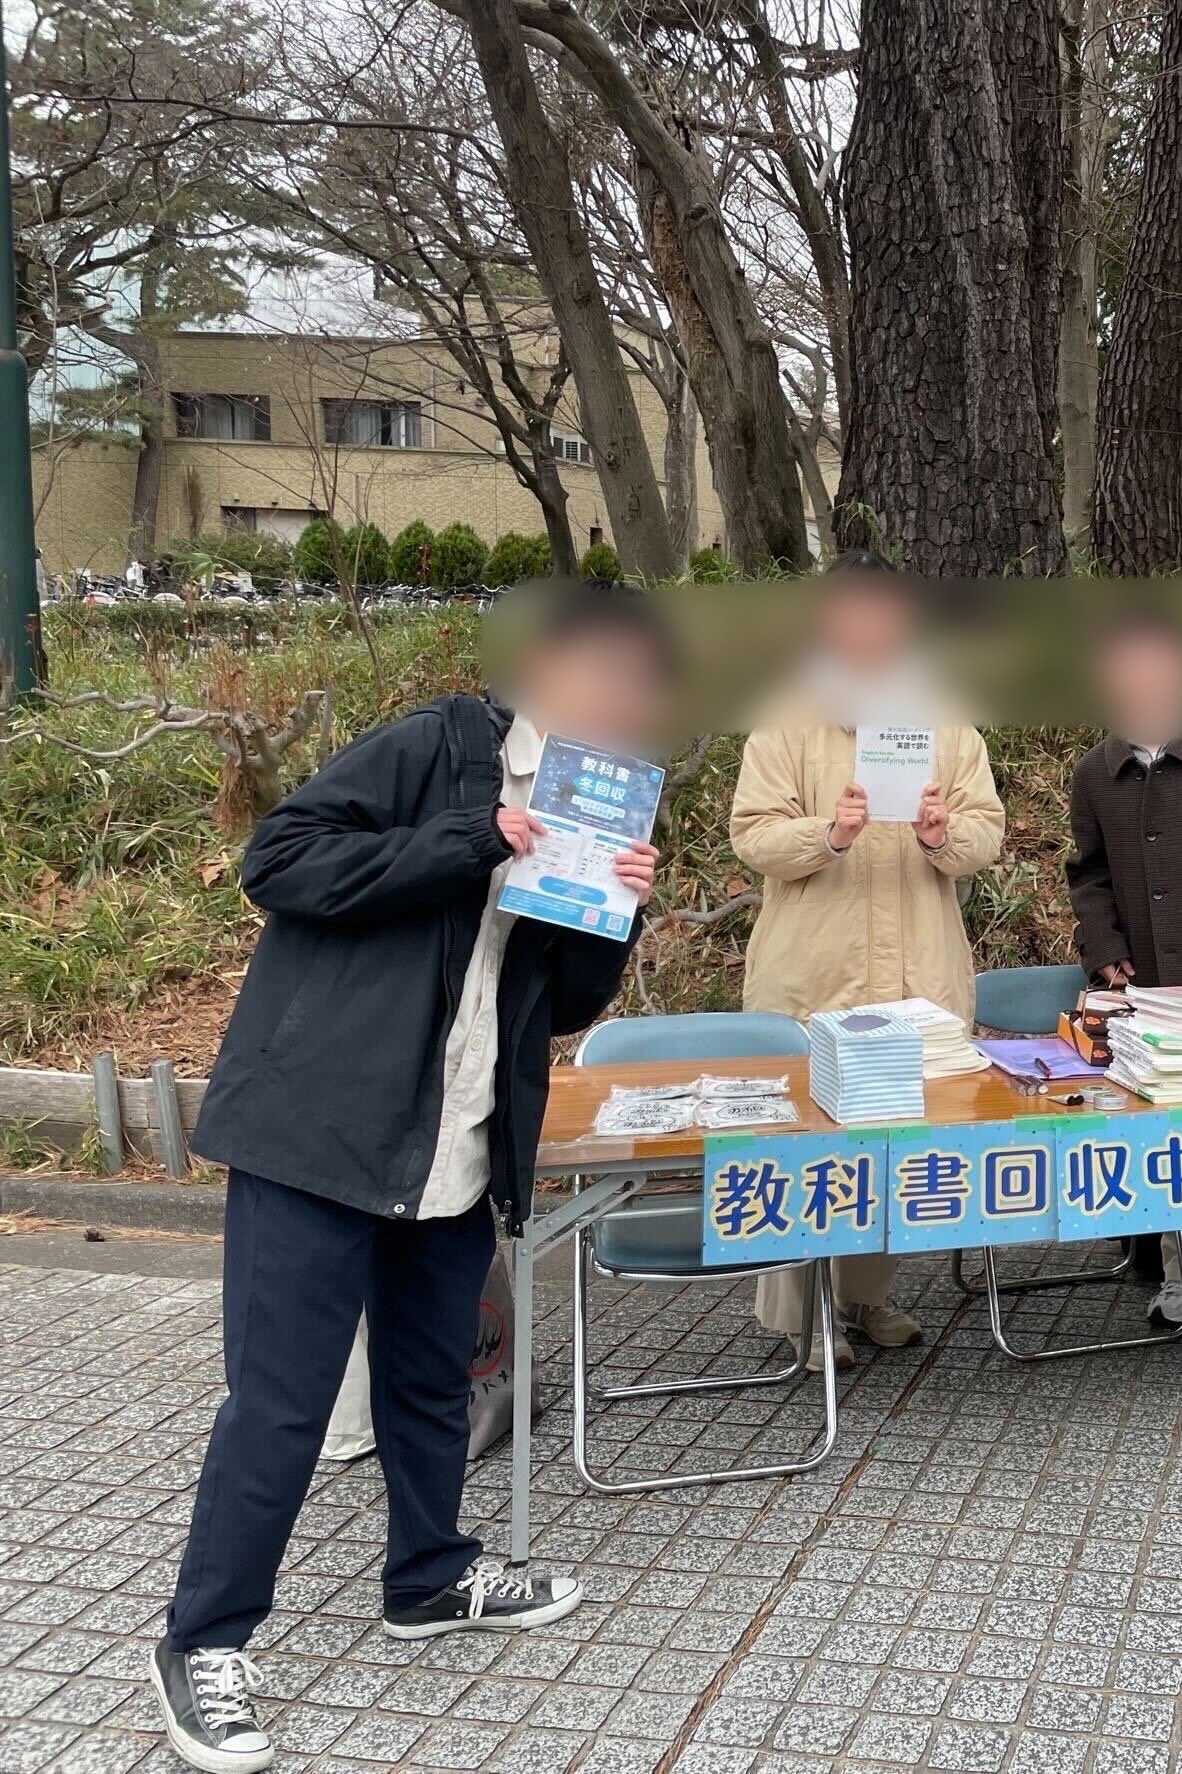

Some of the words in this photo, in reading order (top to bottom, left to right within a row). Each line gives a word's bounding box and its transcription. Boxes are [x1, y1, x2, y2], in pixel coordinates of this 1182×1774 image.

[581, 756, 630, 783] 教科書
[579, 776, 626, 803] 冬回収
